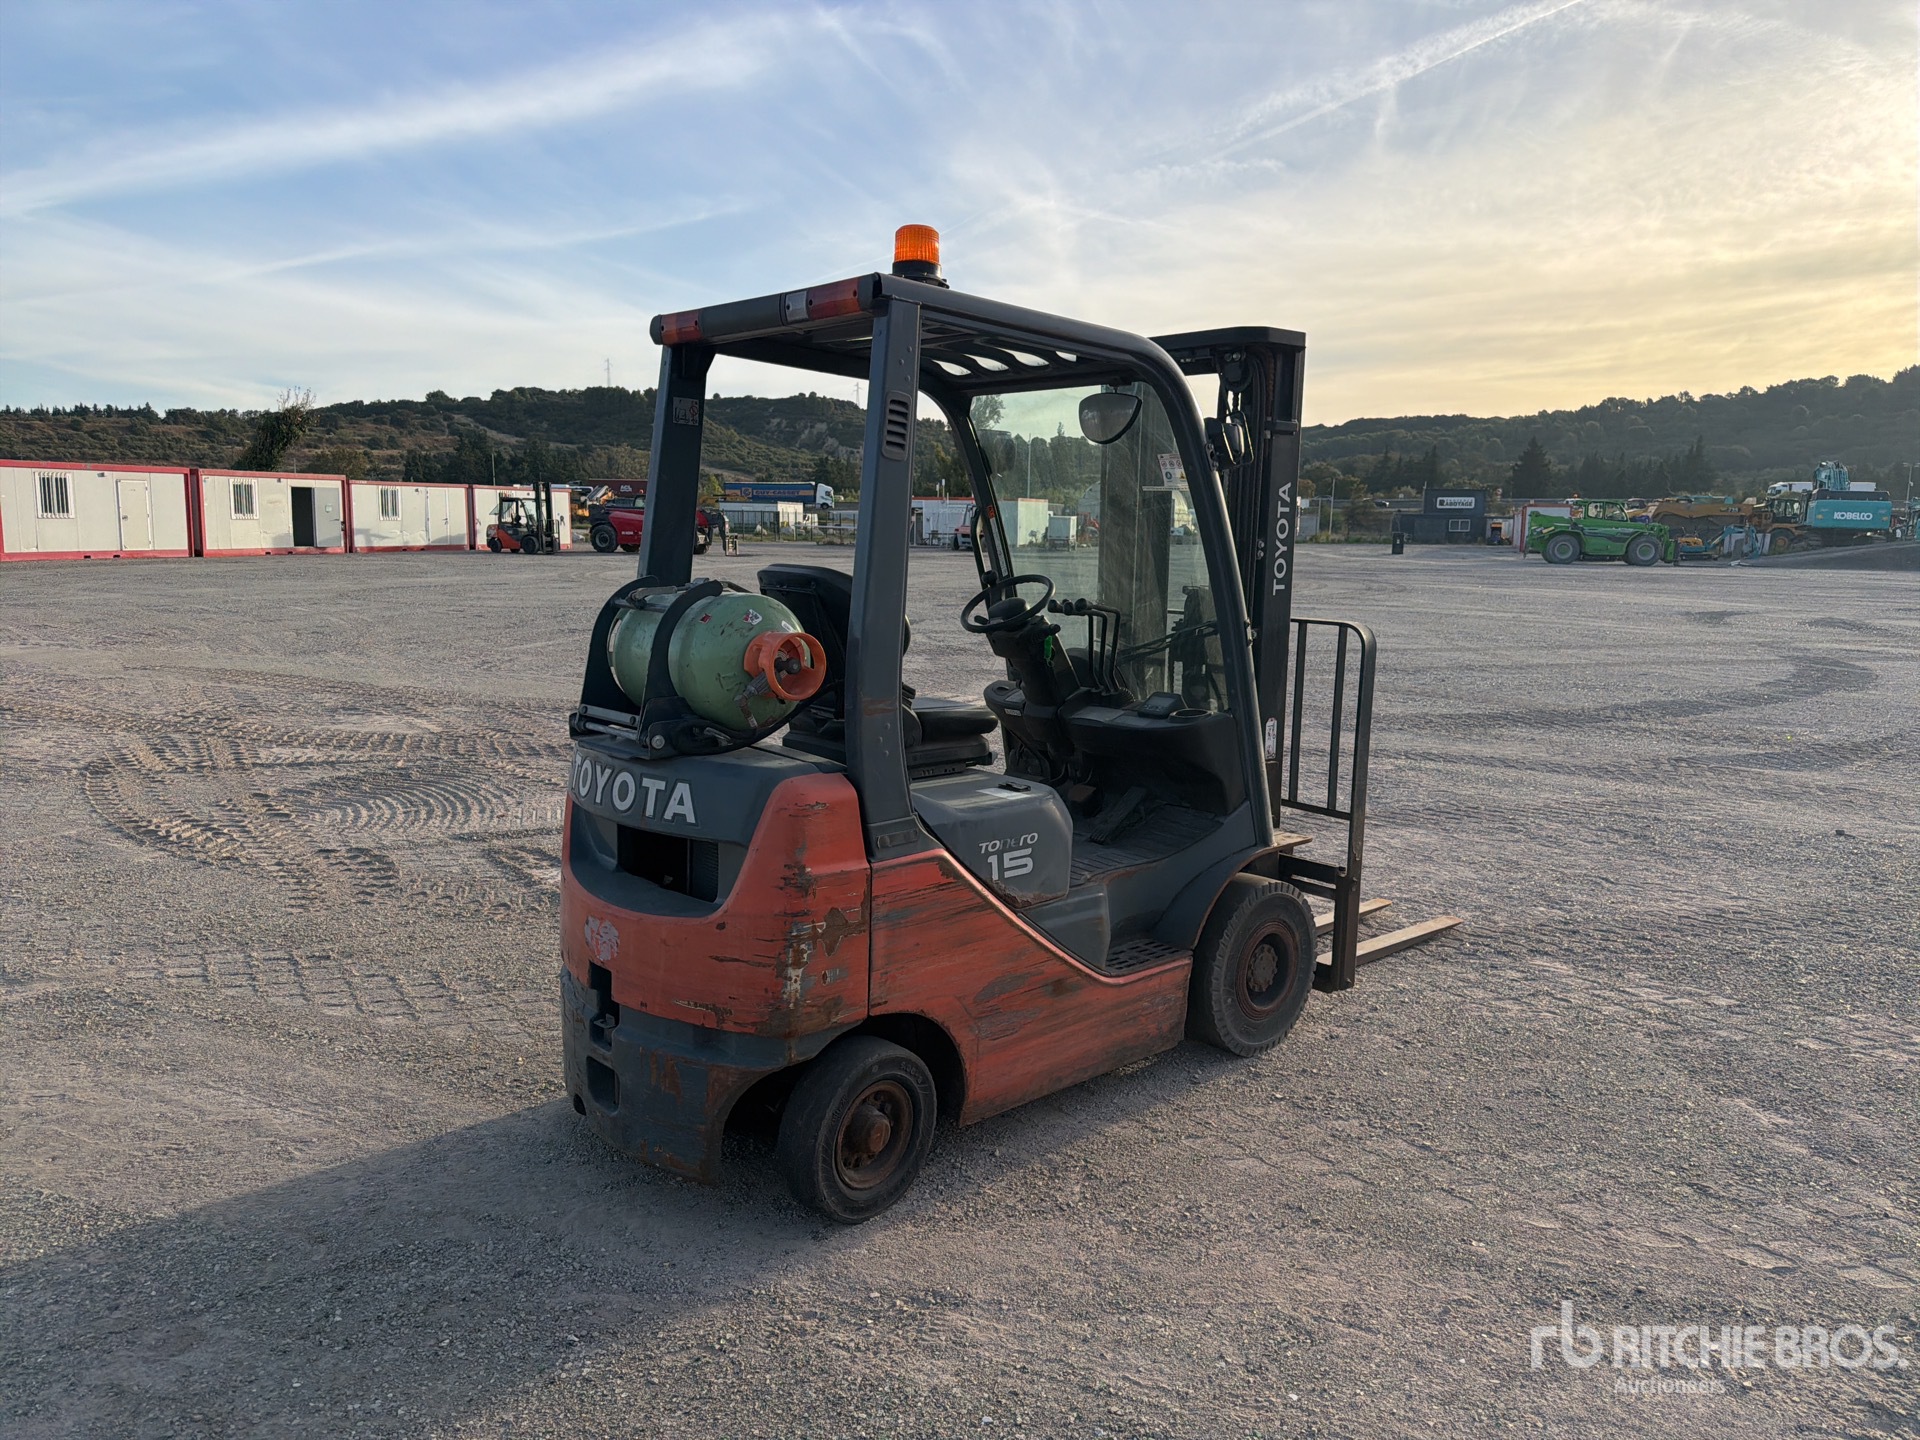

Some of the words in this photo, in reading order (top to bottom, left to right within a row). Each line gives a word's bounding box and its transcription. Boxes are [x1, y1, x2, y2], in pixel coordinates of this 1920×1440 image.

[1272, 482, 1292, 596] TOYOTA
[1833, 511, 1873, 521] KOBELCO
[572, 753, 696, 824] TOYOTA
[987, 847, 1034, 881] 15
